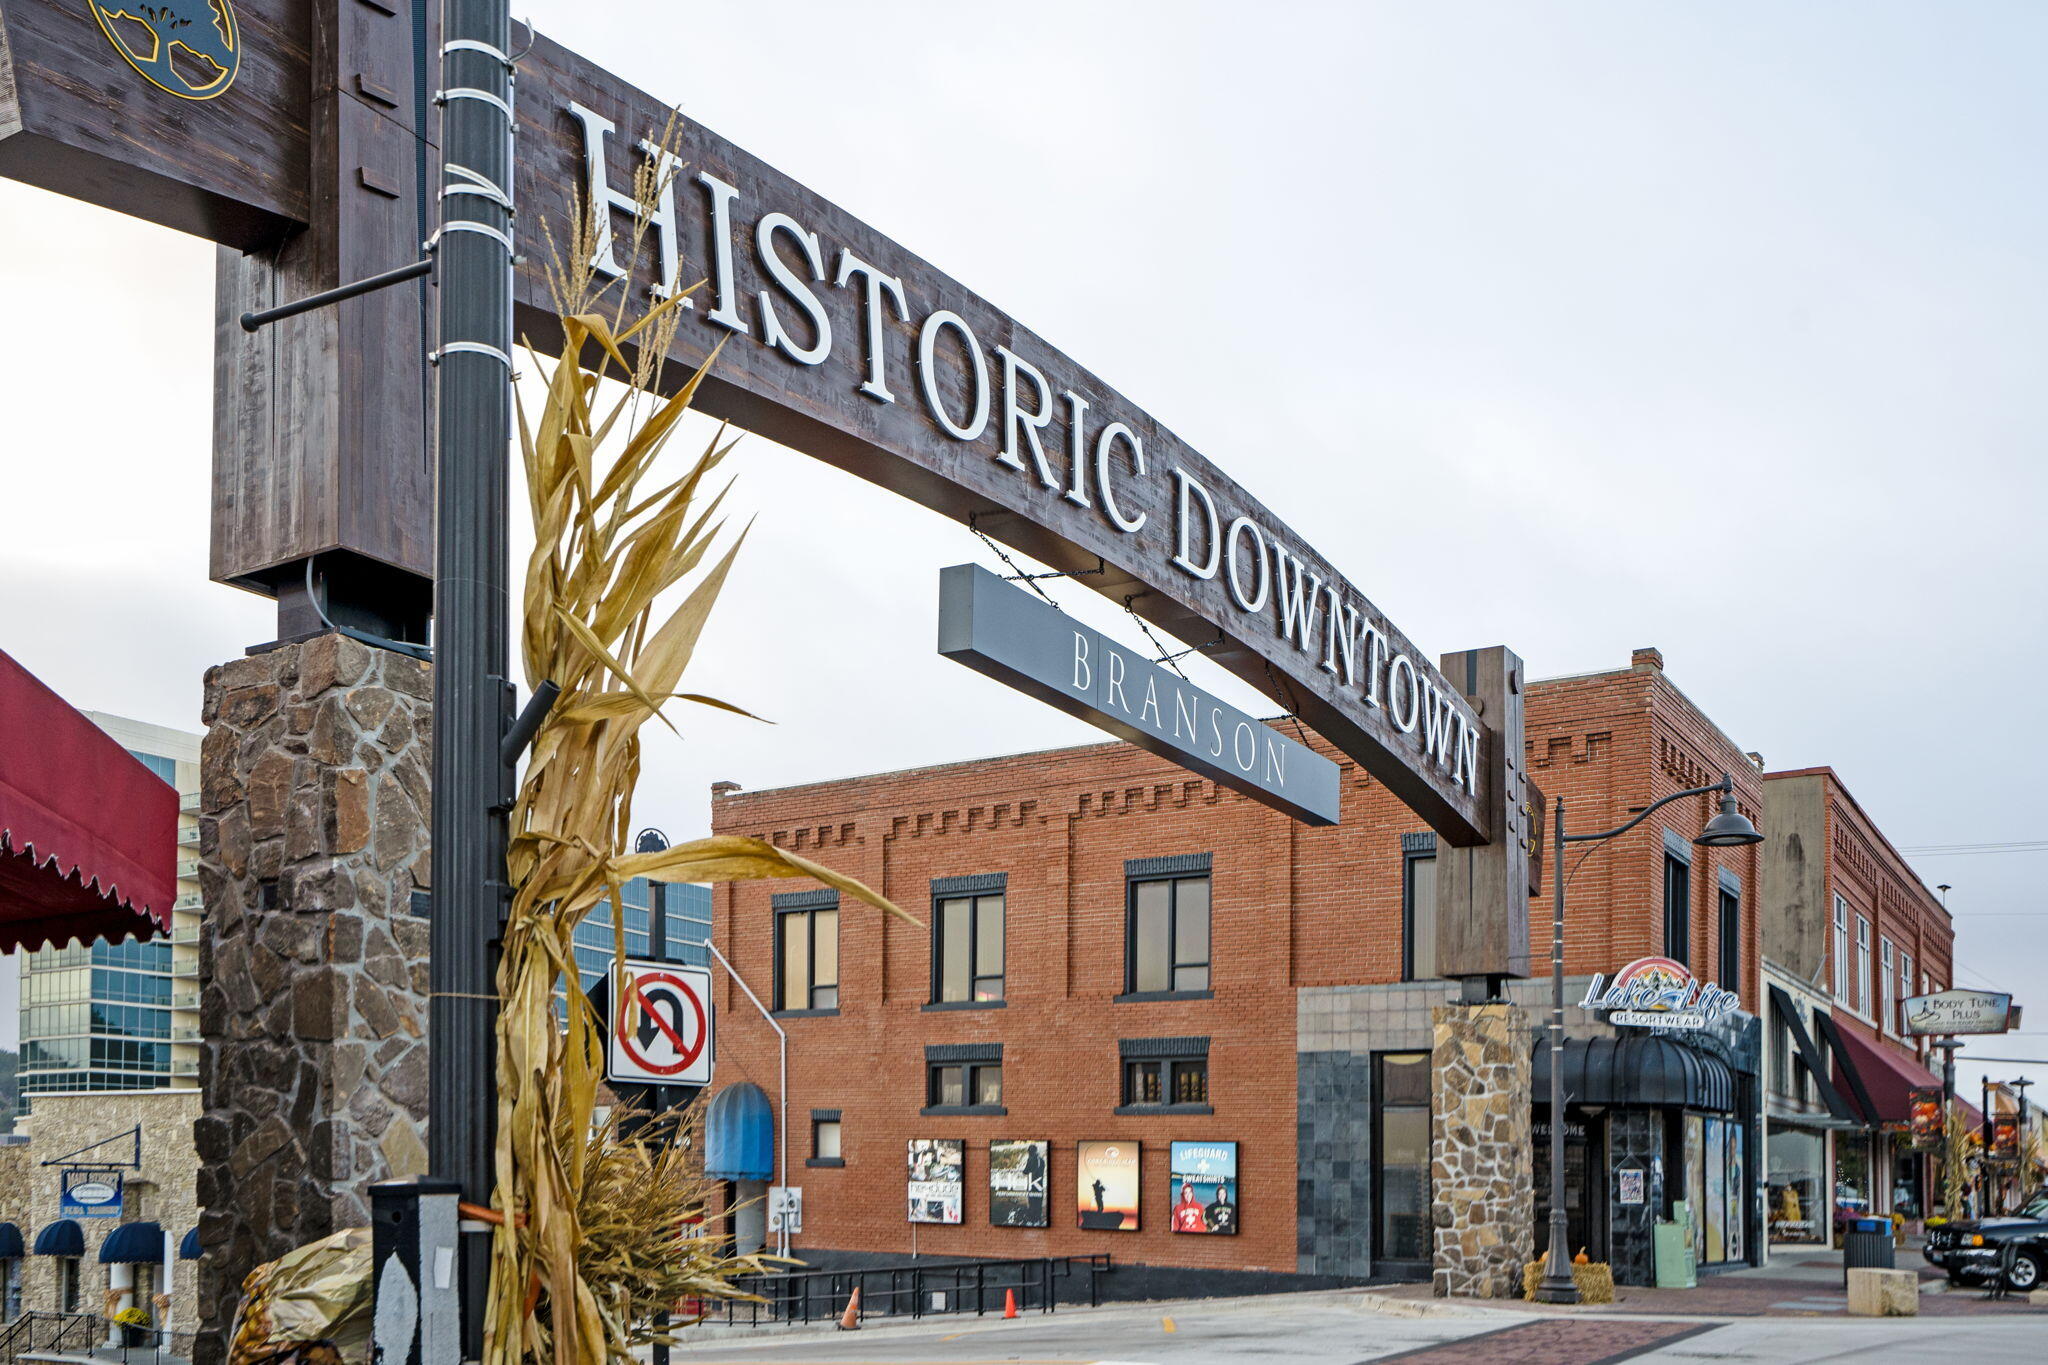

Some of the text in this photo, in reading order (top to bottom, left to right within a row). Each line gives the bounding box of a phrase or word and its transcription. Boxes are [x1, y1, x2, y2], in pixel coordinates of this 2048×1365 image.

[568, 101, 1480, 797] HISTORIC DOWNTOWN
[1072, 631, 1286, 788] BRANSON
[1578, 972, 1740, 1022] Lake Life
[1615, 1013, 1700, 1027] RESORTWEAR
[1952, 1009, 1981, 1020] PLUS
[1531, 1123, 1586, 1136] WELOME
[1180, 1147, 1229, 1161] LIFEGUARD
[1182, 1173, 1226, 1184] SWEATSHIRTS
